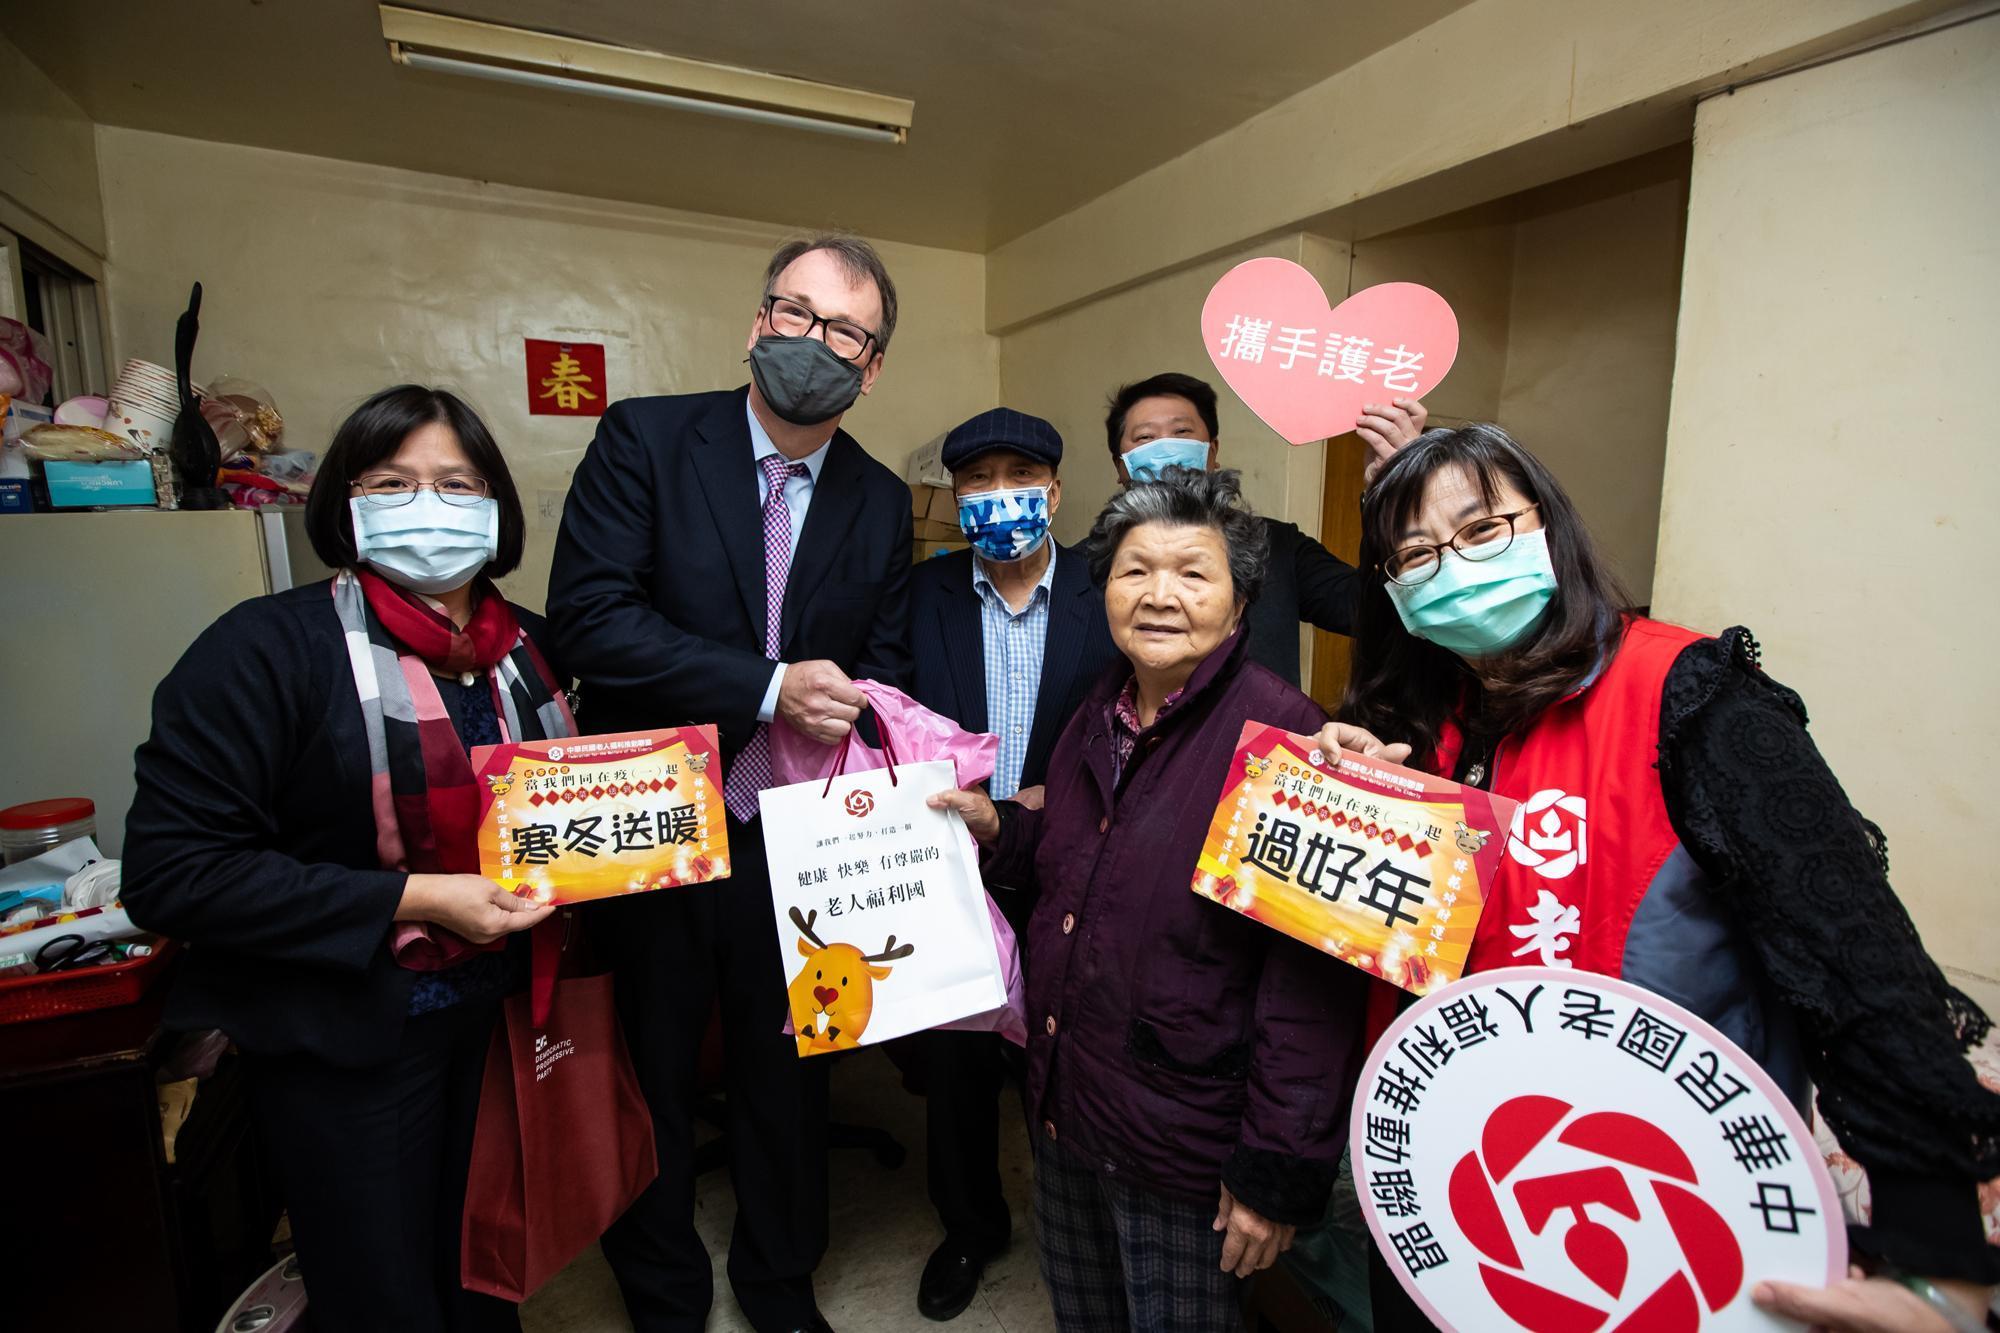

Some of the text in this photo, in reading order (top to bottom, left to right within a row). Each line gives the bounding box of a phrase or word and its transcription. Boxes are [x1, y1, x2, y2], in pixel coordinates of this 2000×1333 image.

[539, 352, 599, 409] 春
[1220, 314, 1425, 393] 攜手護老
[511, 803, 700, 865] 寒冬送暖
[798, 846, 940, 887] 健康 快樂 有尊嚴的
[1240, 812, 1431, 928] 過好年
[824, 880, 926, 918] 老人福利國
[1508, 889, 1581, 968] 老
[535, 1039, 572, 1064] DEMOCRATIC
[535, 1046, 575, 1073] PROGRESSIVE
[536, 1066, 553, 1082] PARTY
[1364, 984, 1816, 1279] 中華民國老人福利推動聯盟
